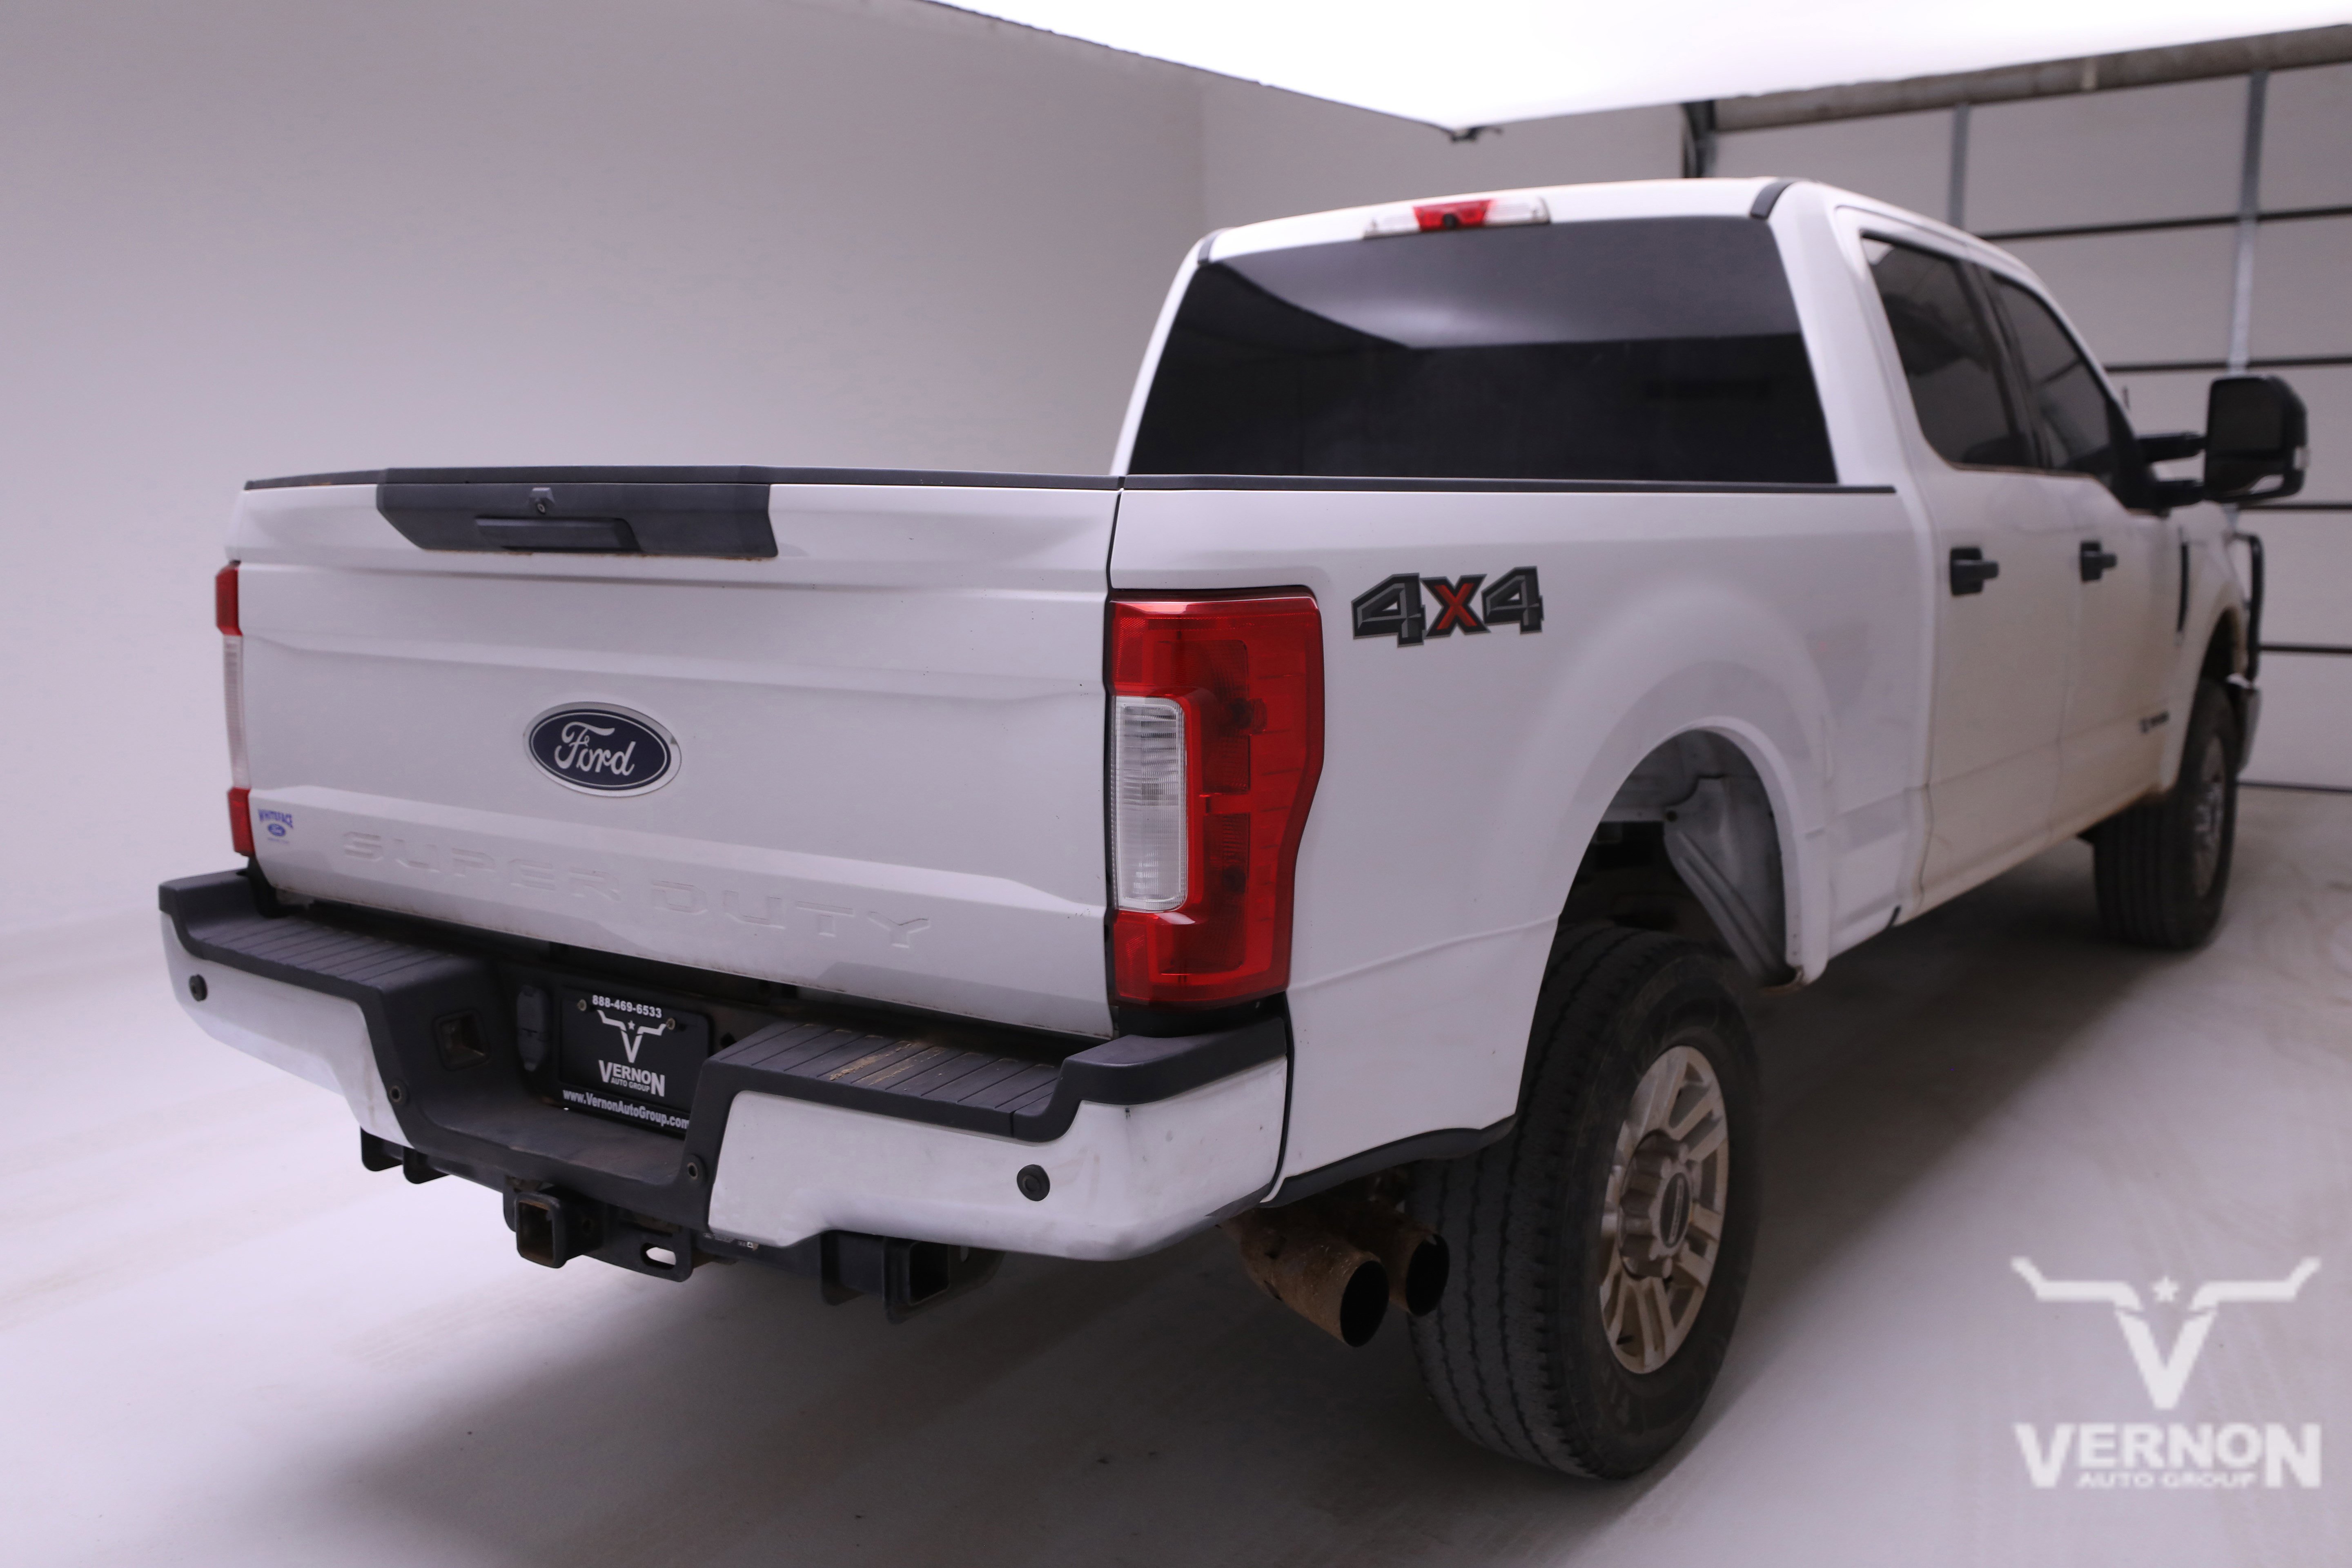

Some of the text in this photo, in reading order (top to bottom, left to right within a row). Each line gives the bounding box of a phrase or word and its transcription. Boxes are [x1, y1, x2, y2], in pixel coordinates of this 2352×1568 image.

[554, 721, 636, 776] Ford
[343, 830, 931, 949] SUPER DUTY
[592, 995, 662, 1018] 888-469-6533
[598, 1059, 665, 1097] VERNON
[611, 1077, 650, 1092] AUTO GROUP
[563, 1089, 689, 1129] www.VernonAutoGroup.com
